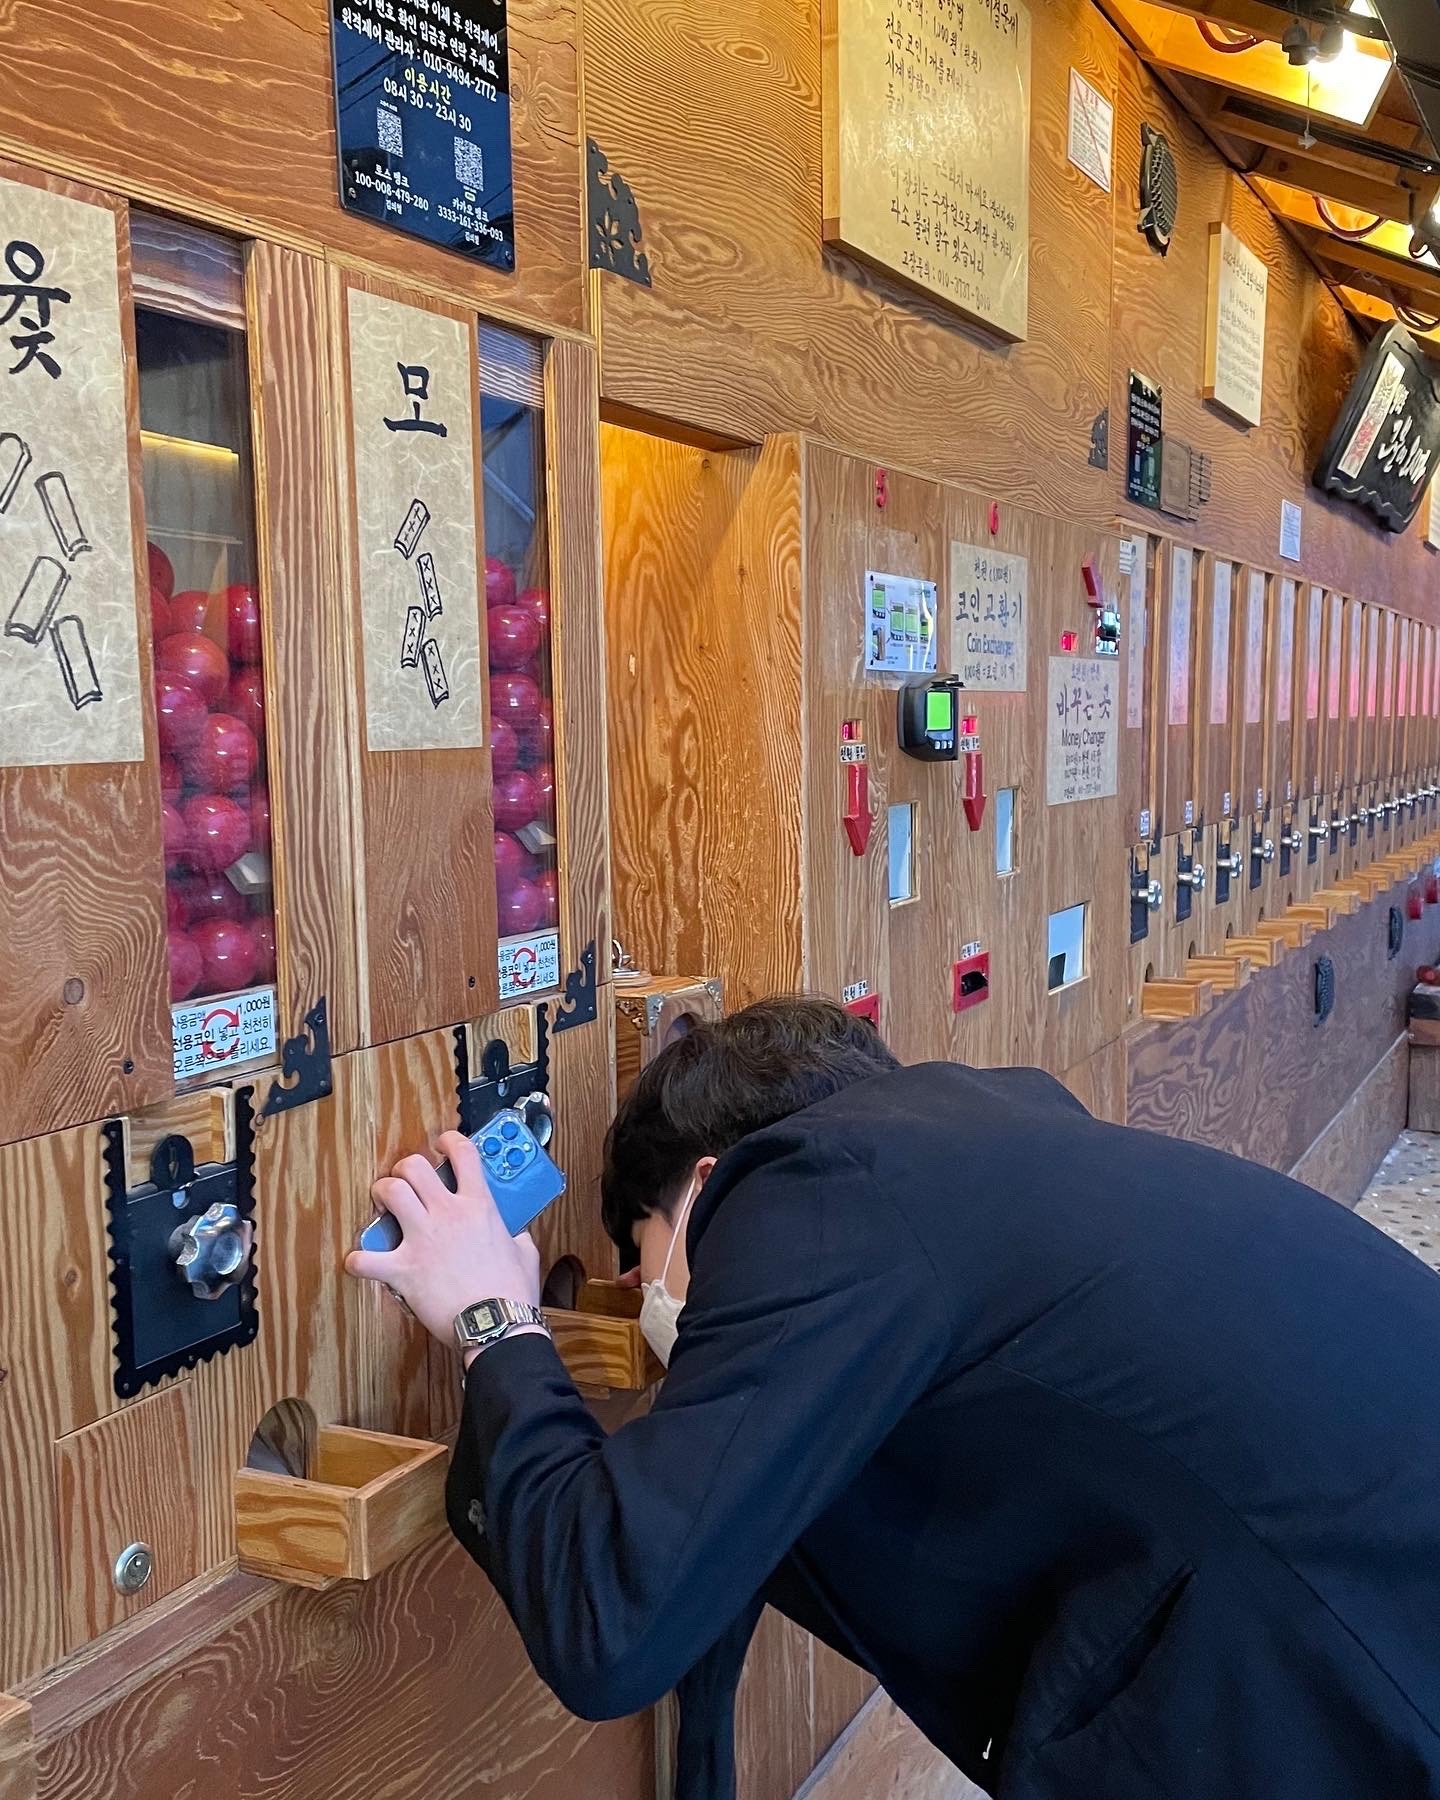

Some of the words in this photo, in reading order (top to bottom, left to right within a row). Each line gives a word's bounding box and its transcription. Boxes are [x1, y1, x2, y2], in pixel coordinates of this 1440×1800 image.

[375, 0, 397, 22] 번호
[398, 7, 417, 35] 확인
[450, 37, 468, 61] 연락
[431, 1, 450, 27] 이체
[452, 12, 463, 32] 후
[341, 6, 382, 44] 원격제어
[384, 28, 415, 60] 관리자
[423, 49, 497, 103] 010-9494-2772
[905, 32, 922, 63] 코인
[383, 76, 407, 103] 08시
[409, 90, 424, 109] 30
[435, 102, 457, 127] 23시
[458, 113, 472, 132] 30
[404, 67, 452, 106] 이용시간
[354, 170, 429, 212] 100-008-479-280
[452, 197, 474, 216] 카카오
[437, 204, 504, 242] 3333-161-336-093
[0, 240, 71, 380] 윷
[382, 361, 448, 438] 모
[955, 586, 981, 623] 코인
[966, 632, 981, 653] Coin
[1061, 728, 1081, 750] Money
[1082, 727, 1106, 748] Changer
[242, 1014, 272, 1036] 천천히
